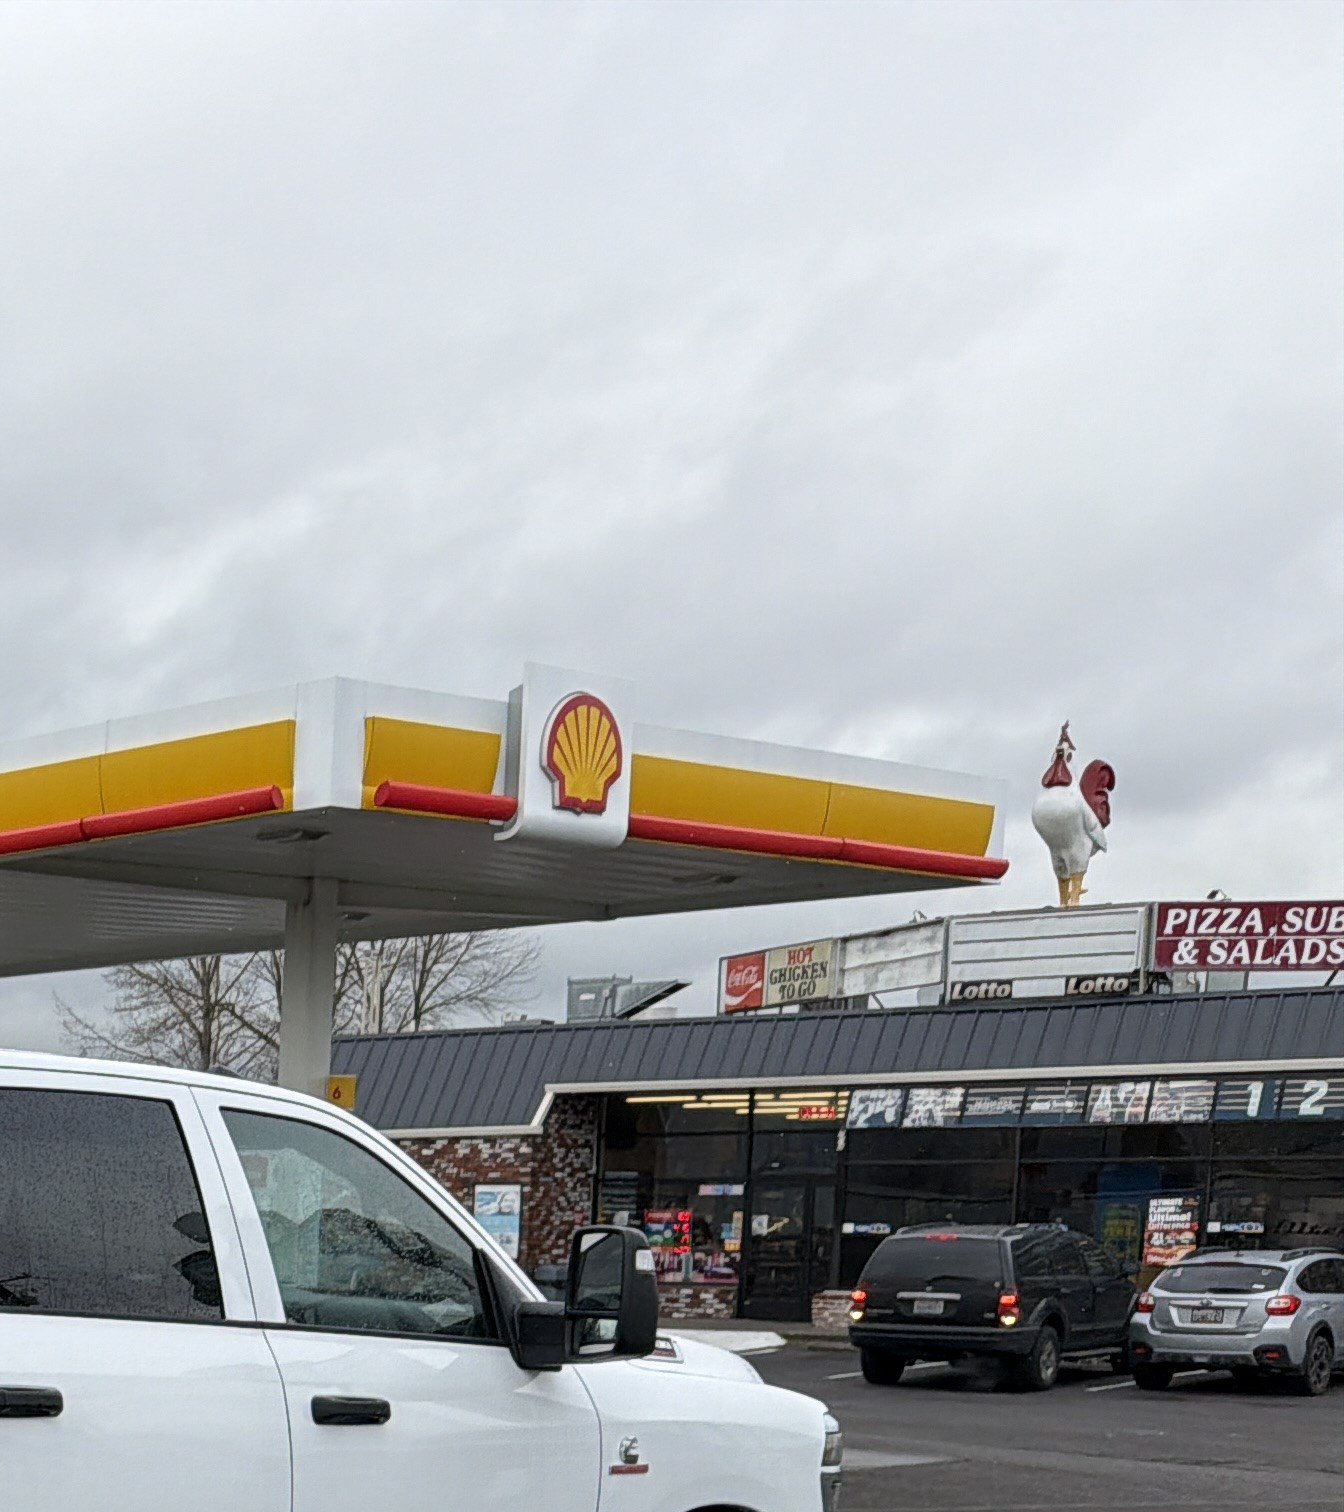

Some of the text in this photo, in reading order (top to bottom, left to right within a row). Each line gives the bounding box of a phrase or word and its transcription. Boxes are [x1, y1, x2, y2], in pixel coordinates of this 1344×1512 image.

[787, 946, 815, 965] HOT
[1173, 938, 1344, 965] & SALADS
[769, 961, 828, 985] CHICKEN
[778, 981, 816, 1000] TO GO
[952, 982, 1011, 999] Lotto
[1067, 977, 1129, 995] Lotto
[332, 1086, 341, 1099] 6
